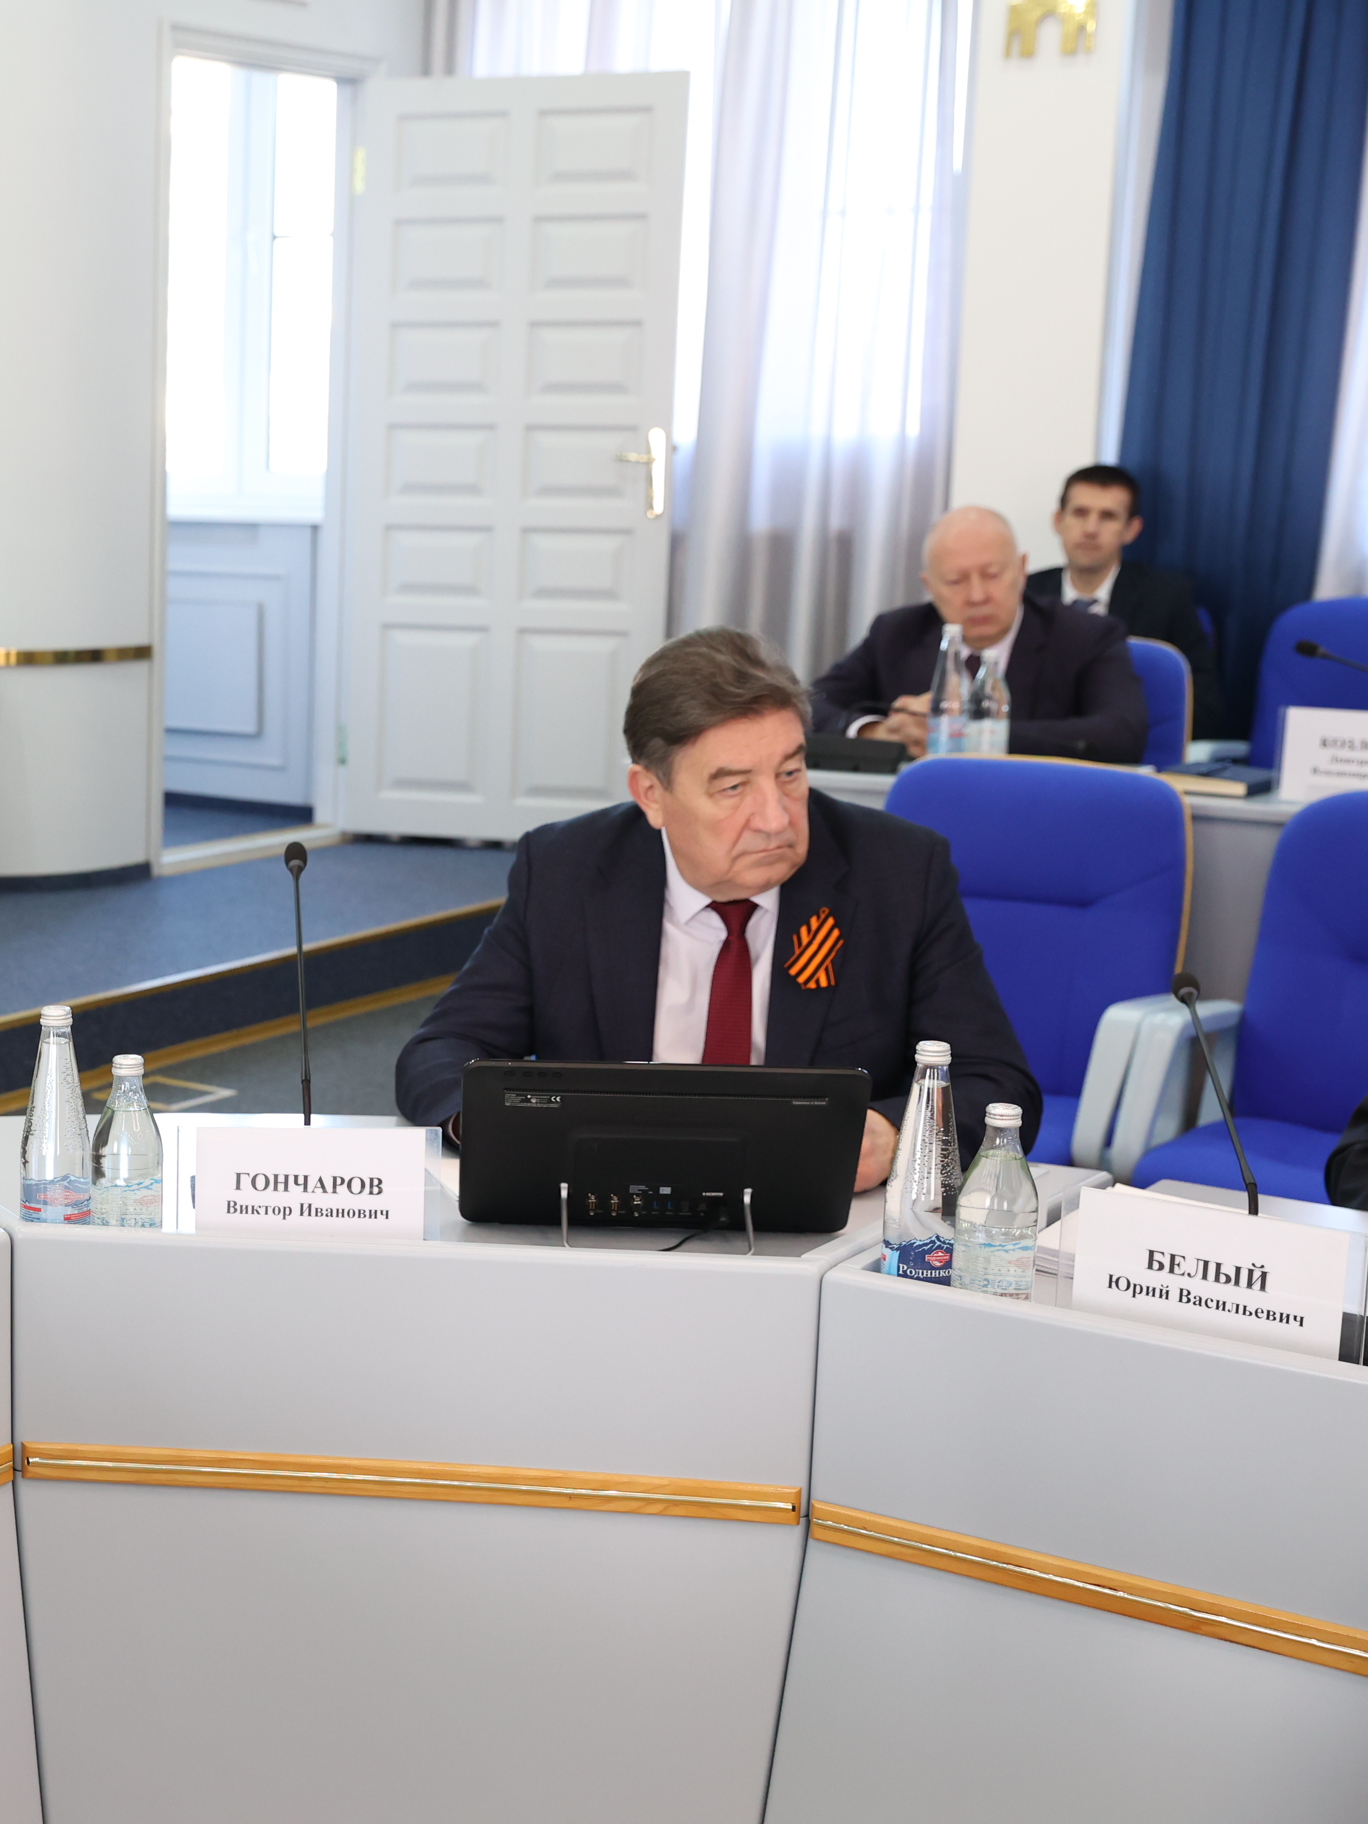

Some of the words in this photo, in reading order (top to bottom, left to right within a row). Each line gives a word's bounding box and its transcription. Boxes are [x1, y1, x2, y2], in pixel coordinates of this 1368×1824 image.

[234, 1172, 384, 1196] ГОНЧАРОВ
[226, 1200, 293, 1220] Виктор
[299, 1202, 390, 1220] Иванович
[1145, 1249, 1271, 1293] БЕЛЫЙ
[1107, 1273, 1170, 1300] Юрий
[1178, 1287, 1305, 1328] Васильевич
